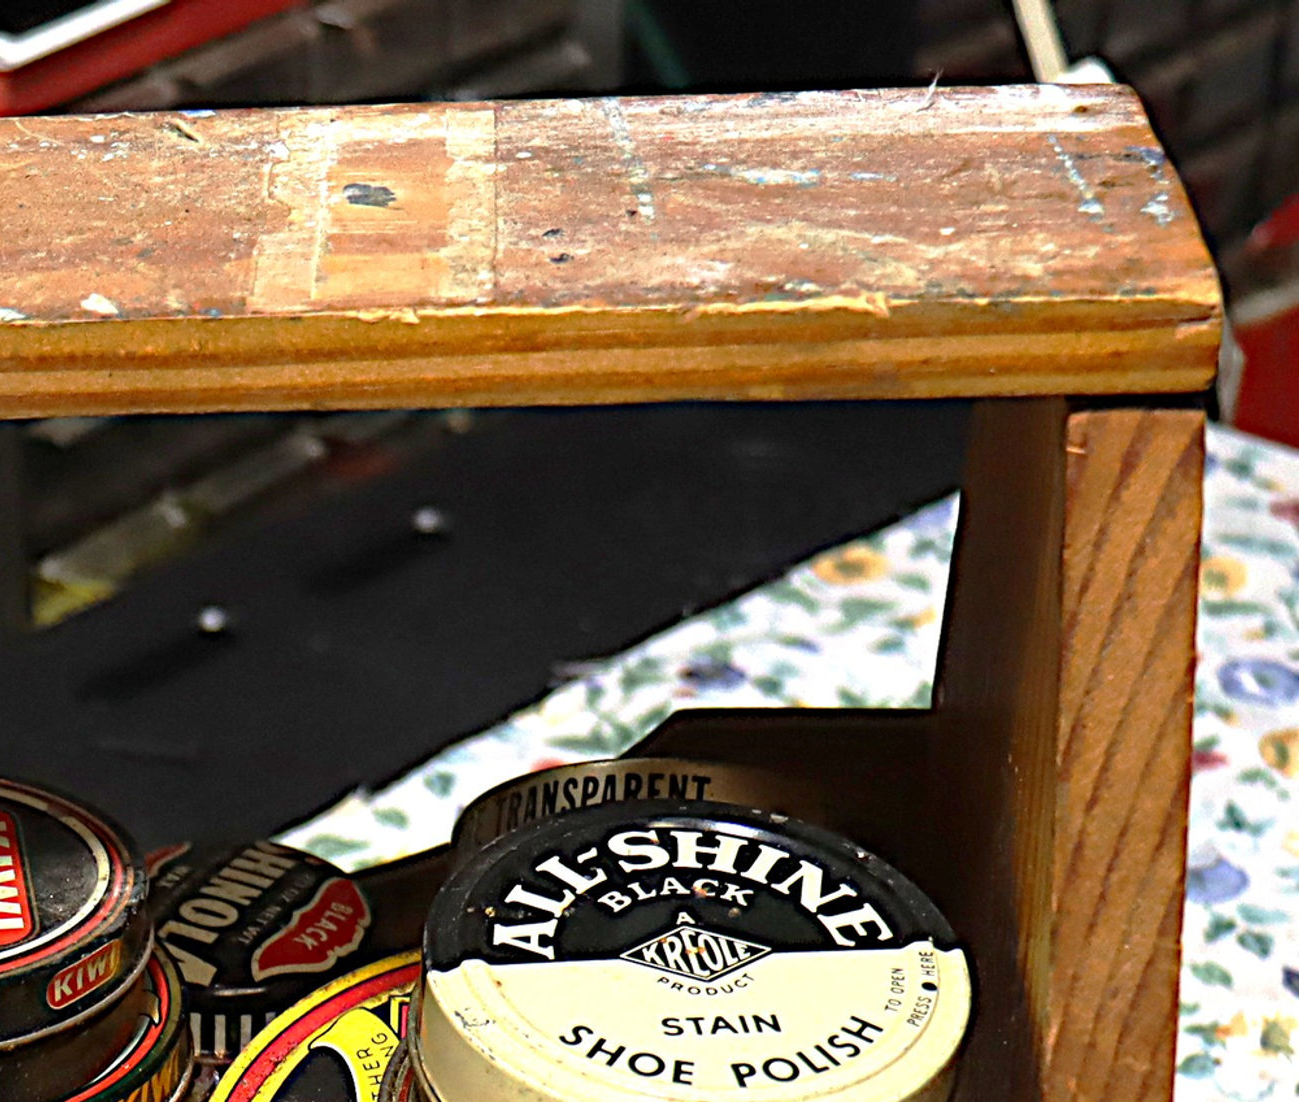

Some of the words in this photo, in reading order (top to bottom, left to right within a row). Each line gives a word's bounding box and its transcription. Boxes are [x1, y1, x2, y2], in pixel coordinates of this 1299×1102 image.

[496, 773, 711, 838] TRANSPARENT
[491, 828, 894, 960] ALL-SHINE
[597, 877, 755, 914] BLACK
[675, 911, 694, 925] A
[292, 901, 354, 951] BLACK
[53, 950, 122, 1003] KIWI
[640, 932, 752, 980] KREOLE
[656, 973, 755, 998] PRODUCT
[890, 967, 906, 994] OPEN
[906, 996, 932, 1027] PRESS
[919, 951, 935, 976] HERE
[661, 1013, 783, 1037] STAIN
[884, 998, 902, 1012] TO
[559, 1024, 696, 1086] SHOE
[730, 1014, 885, 1088] POLISH
